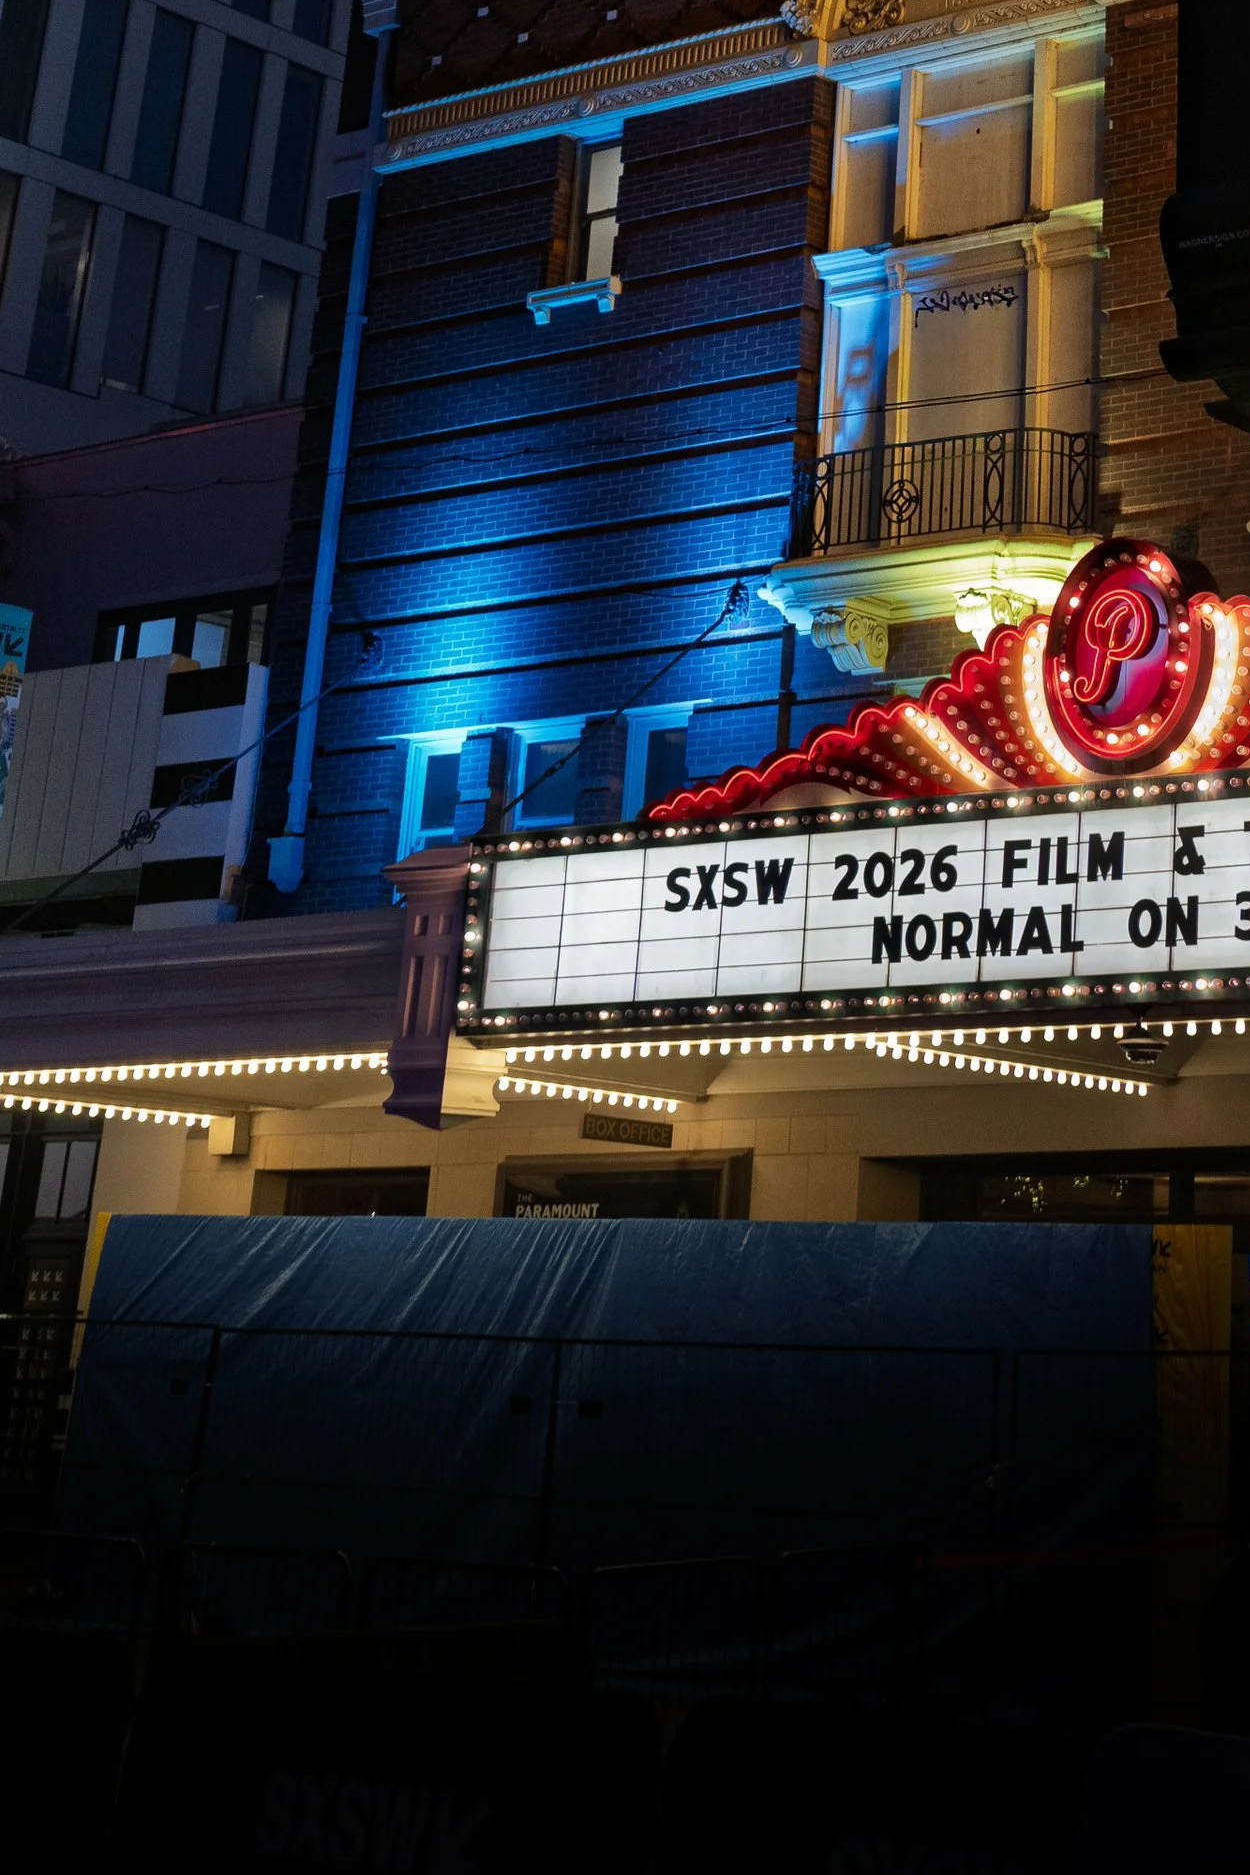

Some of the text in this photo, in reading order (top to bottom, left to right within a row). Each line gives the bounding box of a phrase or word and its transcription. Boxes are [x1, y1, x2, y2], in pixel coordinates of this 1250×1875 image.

[664, 857, 795, 912] SXSW
[831, 844, 960, 901] 2026
[1001, 831, 1126, 889] FILM
[1172, 825, 1206, 875] &
[872, 903, 1084, 964] NORMAL
[1128, 895, 1199, 949] ON
[586, 1116, 671, 1144] BOX OFFICE
[515, 1202, 600, 1219] PARAMOUNT
[517, 1193, 533, 1203] THE
